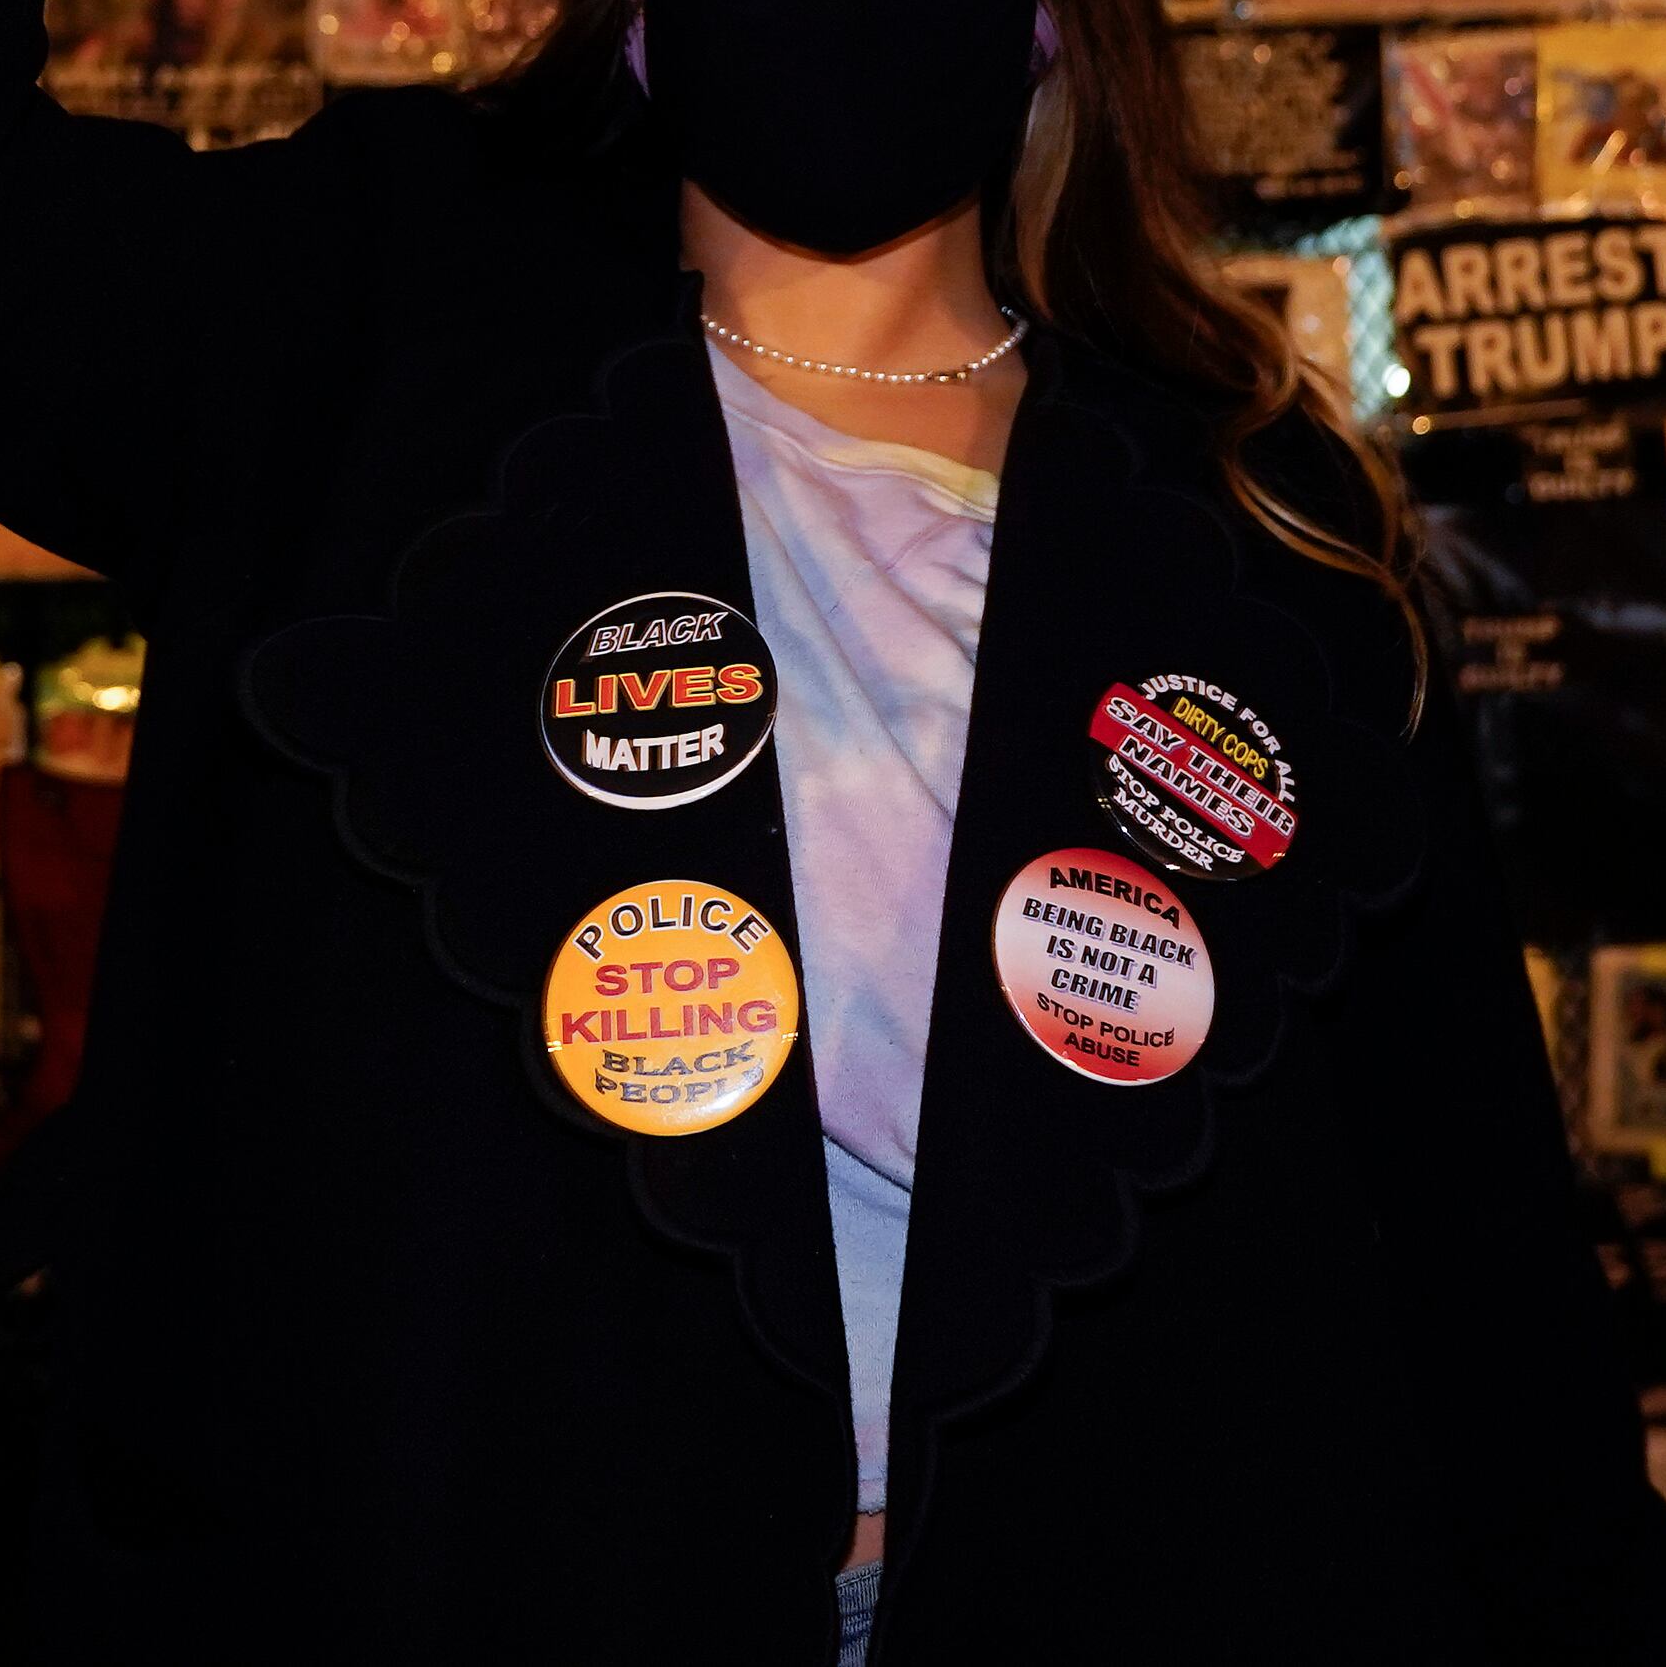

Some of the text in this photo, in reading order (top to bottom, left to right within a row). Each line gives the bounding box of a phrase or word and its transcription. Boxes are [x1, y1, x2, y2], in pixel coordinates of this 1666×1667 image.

[588, 610, 729, 658] BLACK
[554, 662, 764, 719] LIVES
[585, 722, 725, 773] MATTER
[1138, 673, 1297, 805] JUSTICE FOR ALL
[1172, 695, 1270, 781] DIRTY COPS
[1105, 695, 1297, 839] SAY THEIR
[1118, 733, 1257, 839] NAMES
[1107, 753, 1246, 865] STOP POLICE
[1112, 786, 1215, 873] MURDER
[1049, 866, 1181, 930] AMERICA
[573, 894, 771, 961] POLICE
[1022, 897, 1197, 970] BEING BLACK
[594, 957, 741, 997] STOP
[1046, 934, 1158, 989] IS NOT A
[1036, 991, 1176, 1047] STOP POLICE
[1050, 967, 1141, 1014] CRIME
[561, 999, 778, 1045] KILLING
[1064, 1031, 1141, 1068] ABUSE
[602, 1039, 756, 1077] BLACK
